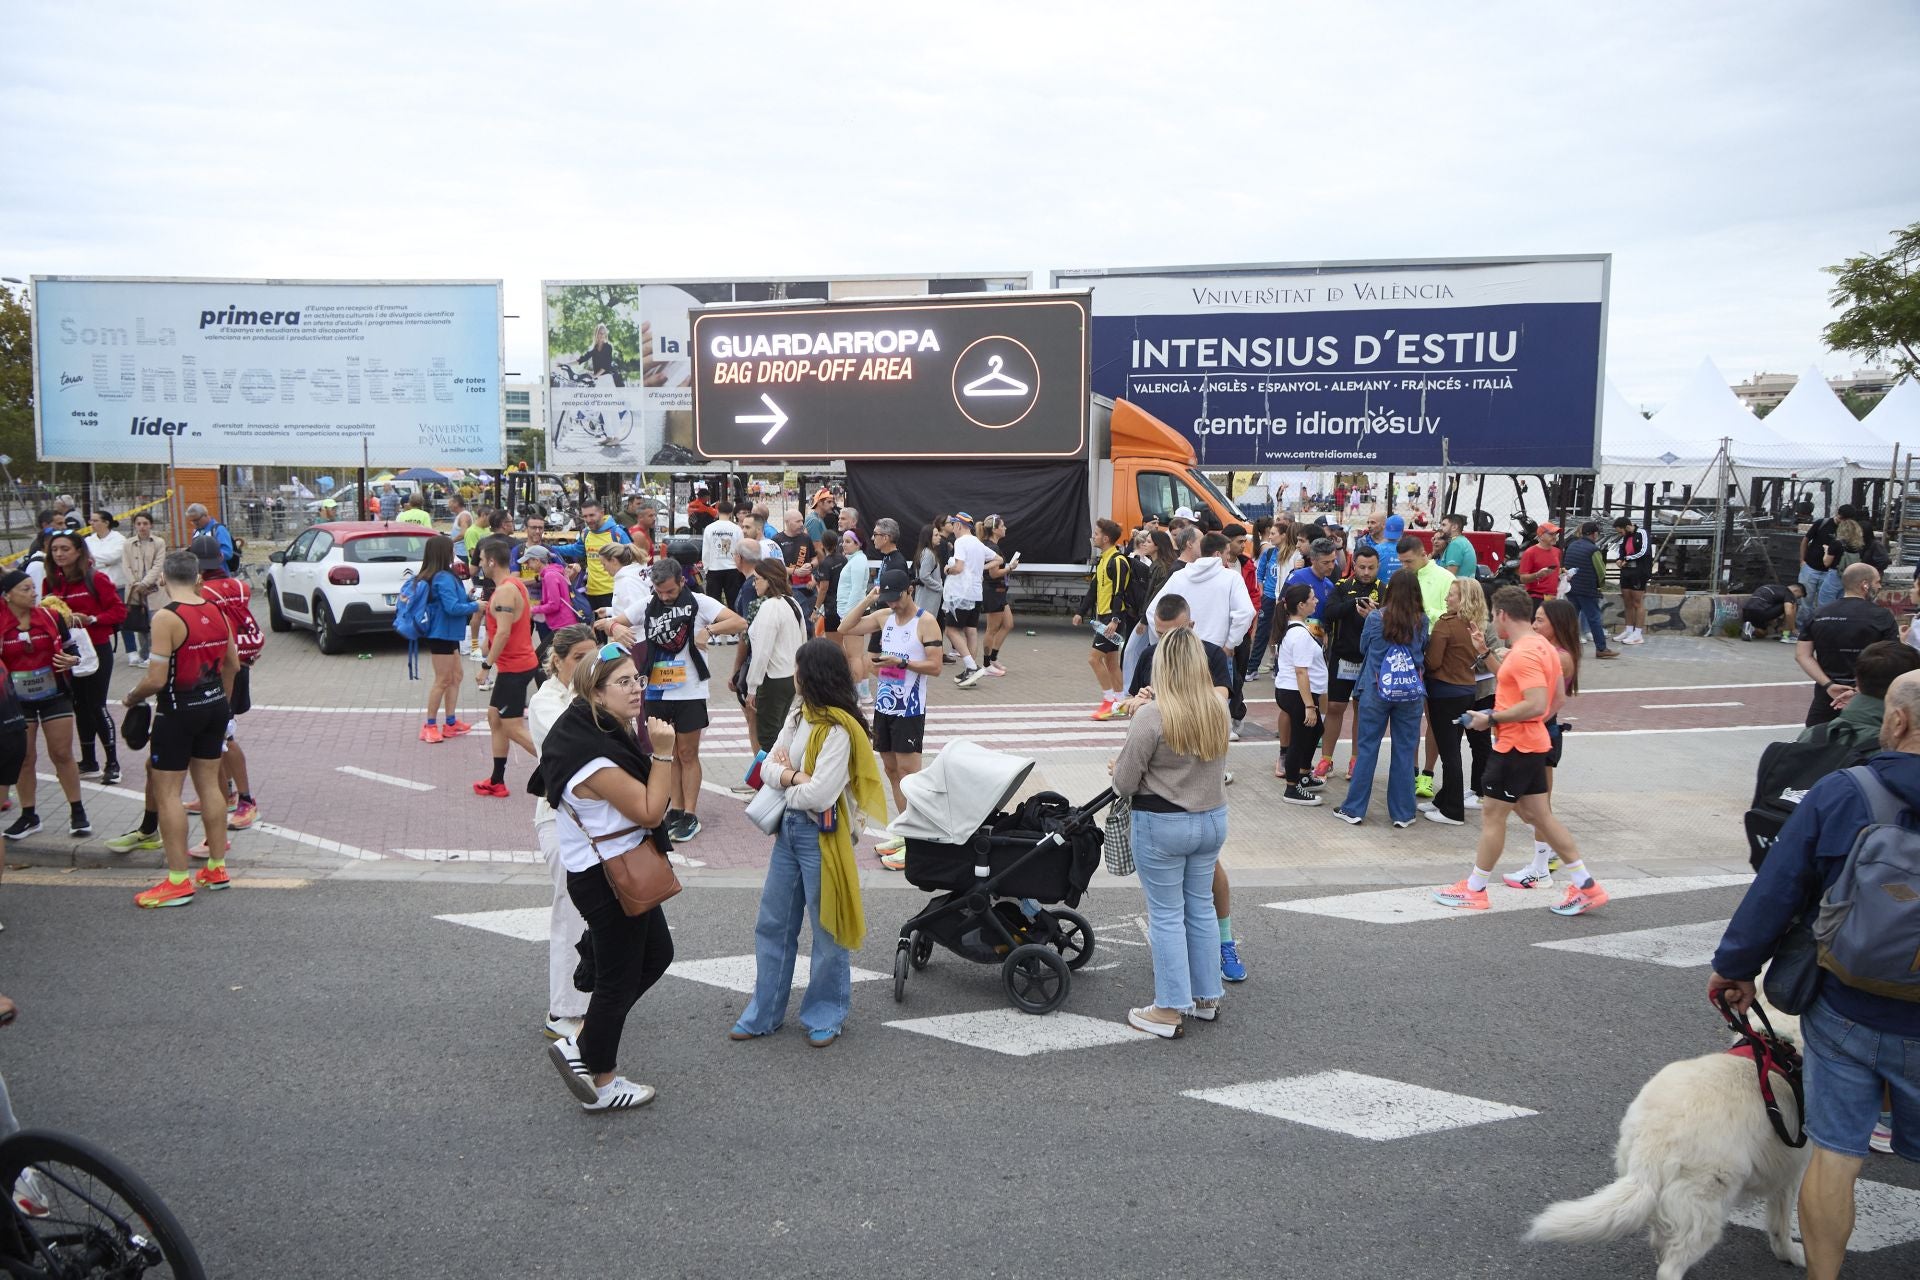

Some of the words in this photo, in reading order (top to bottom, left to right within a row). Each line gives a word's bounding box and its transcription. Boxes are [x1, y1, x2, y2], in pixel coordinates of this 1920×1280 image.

[305, 304, 335, 312] d'Europa
[345, 304, 373, 313] recepció
[374, 303, 408, 311] d'Erasmus
[388, 311, 423, 319] divulgació
[199, 304, 300, 329] primera
[368, 319, 403, 327] programes
[404, 318, 451, 326] internacionals
[60, 316, 128, 346] Som
[136, 316, 177, 346] La
[660, 336, 680, 353] la
[710, 328, 941, 358] GUARDARROPA
[1132, 335, 1339, 369] INTENSIUS
[713, 361, 753, 384] BAG
[757, 358, 857, 383] DROP-OFF
[859, 357, 913, 381] AREA
[1133, 380, 1191, 394] VALENCIÀ
[1199, 378, 1248, 393] ANGLÈS
[1258, 381, 1322, 393] ESPANYOL
[1331, 379, 1391, 392] ALEMANY
[1401, 377, 1462, 391] FRANCÉS
[1472, 375, 1514, 390] ITALIÀ
[561, 399, 590, 407] recepció
[71, 410, 86, 418] des
[88, 410, 98, 418] de
[80, 419, 99, 427] 1499
[130, 416, 188, 436] líder
[212, 422, 243, 430] diversitat
[247, 422, 280, 430] innovació
[1193, 414, 1288, 435] centre
[341, 430, 375, 438] esportives
[1264, 449, 1378, 460] www.centreidiomes.es
